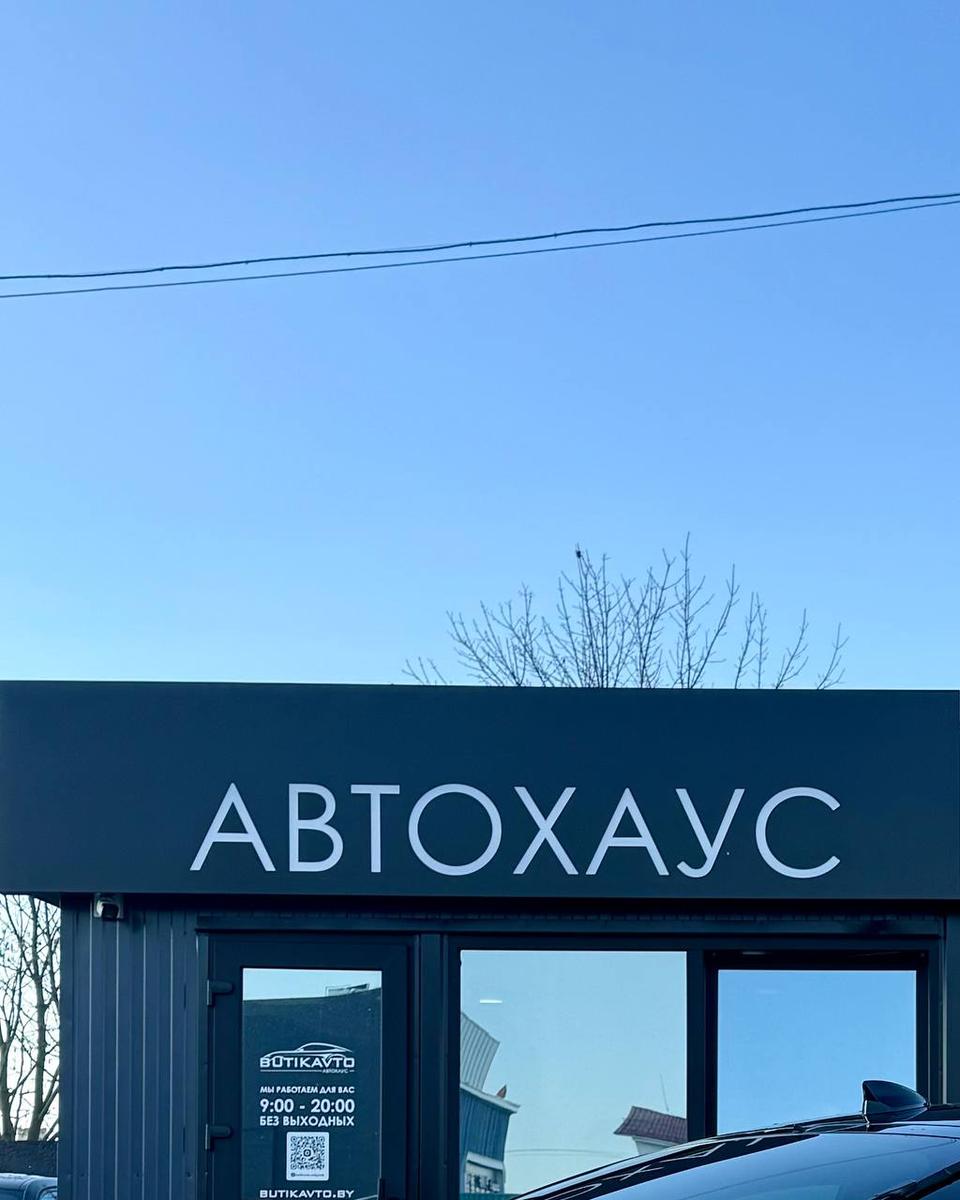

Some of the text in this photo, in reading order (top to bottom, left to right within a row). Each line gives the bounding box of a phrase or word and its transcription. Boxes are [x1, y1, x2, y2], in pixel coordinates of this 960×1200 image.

[190, 783, 841, 879] АВТОХАУС
[260, 1056, 355, 1068] BUTIKAVTO
[260, 1086, 355, 1094] МЫ РАБОТАЕМ ДЛЯ ВАС
[260, 1098, 295, 1113] 9:00
[310, 1098, 355, 1113] 20:00
[260, 1116, 355, 1127] БЕЗ ВЫХОДНЫХ
[260, 1190, 355, 1198] BUTIKAVTO.BY
